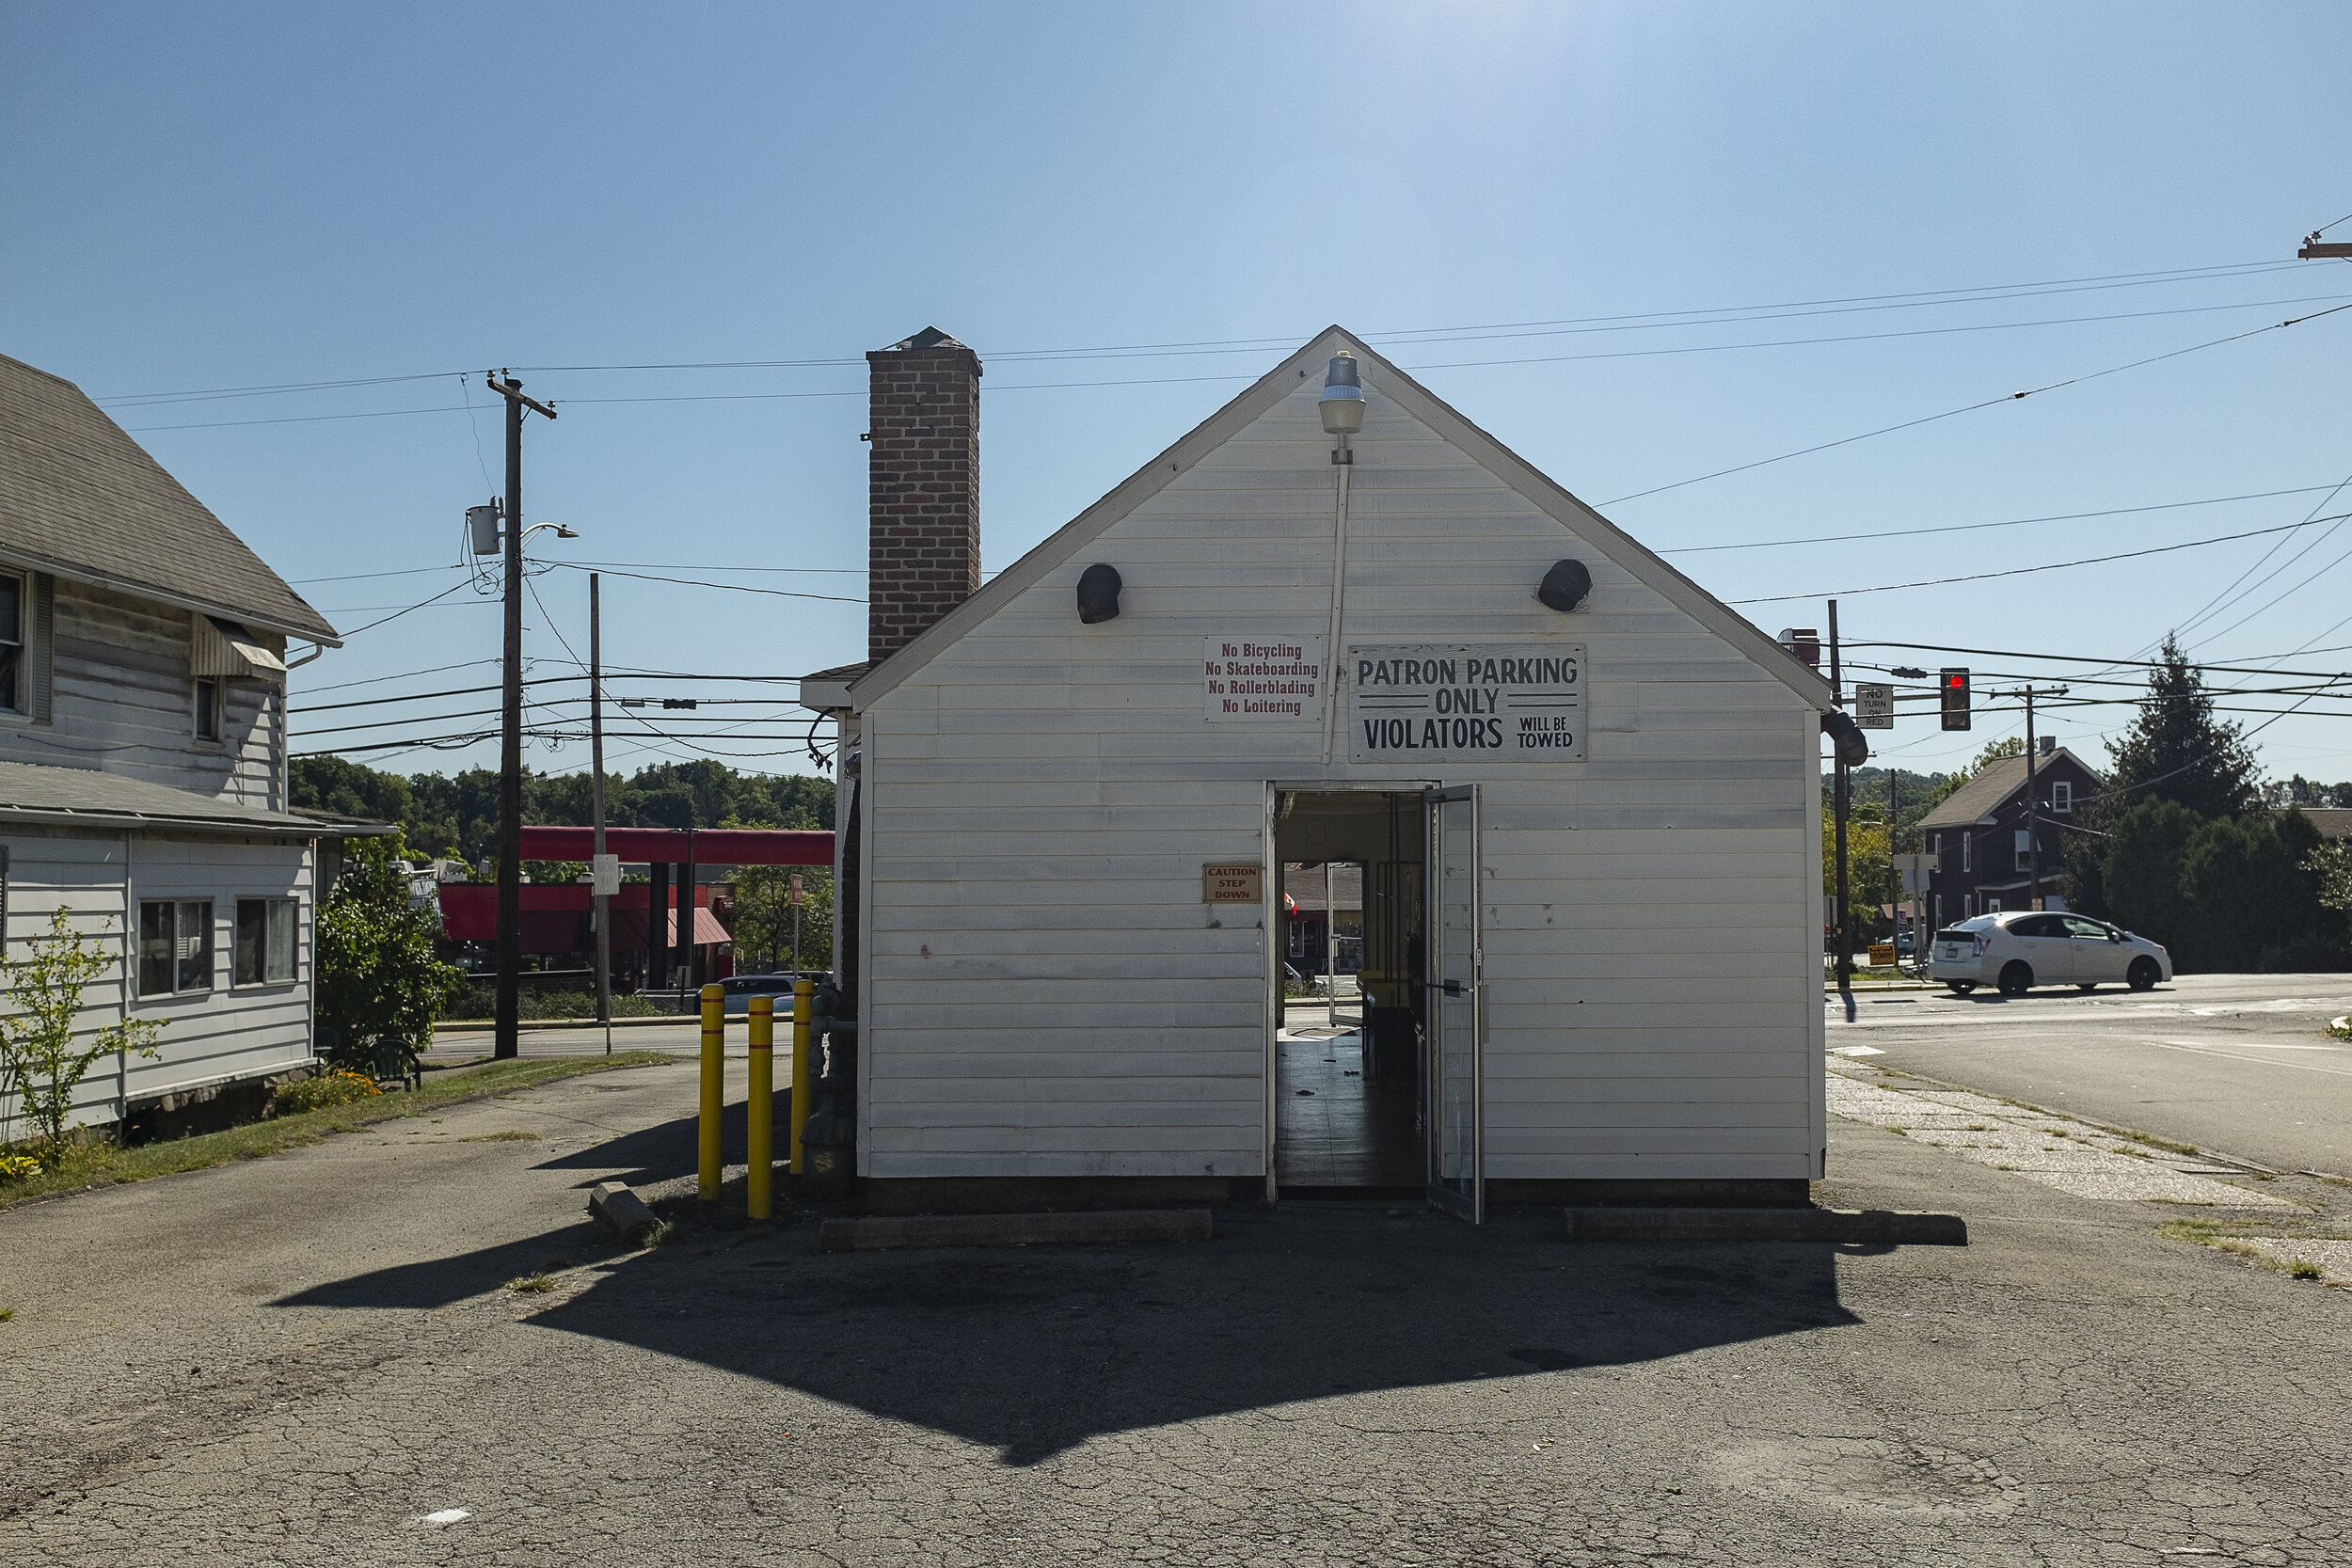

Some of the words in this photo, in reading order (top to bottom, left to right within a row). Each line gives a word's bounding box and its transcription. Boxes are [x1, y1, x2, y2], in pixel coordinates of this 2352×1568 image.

[1222, 643, 1238, 657] No
[1243, 643, 1302, 660] Bicycling
[1205, 661, 1222, 675] No
[1226, 661, 1318, 678] Skateboarding
[1358, 658, 1456, 686] PATRON
[1467, 657, 1578, 685] PARKING
[1208, 680, 1225, 694] No
[1230, 680, 1315, 697] Rollerblading
[1867, 689, 1883, 699] NO
[1222, 699, 1239, 713] No
[1244, 699, 1301, 716] Loitering
[1436, 688, 1499, 714] ONLY
[1519, 717, 1550, 732] WILL
[1552, 717, 1567, 731] BE
[1363, 718, 1503, 750] VIOLATORS
[1517, 732, 1573, 749] TOWED
[1215, 891, 1250, 899] DOWN
